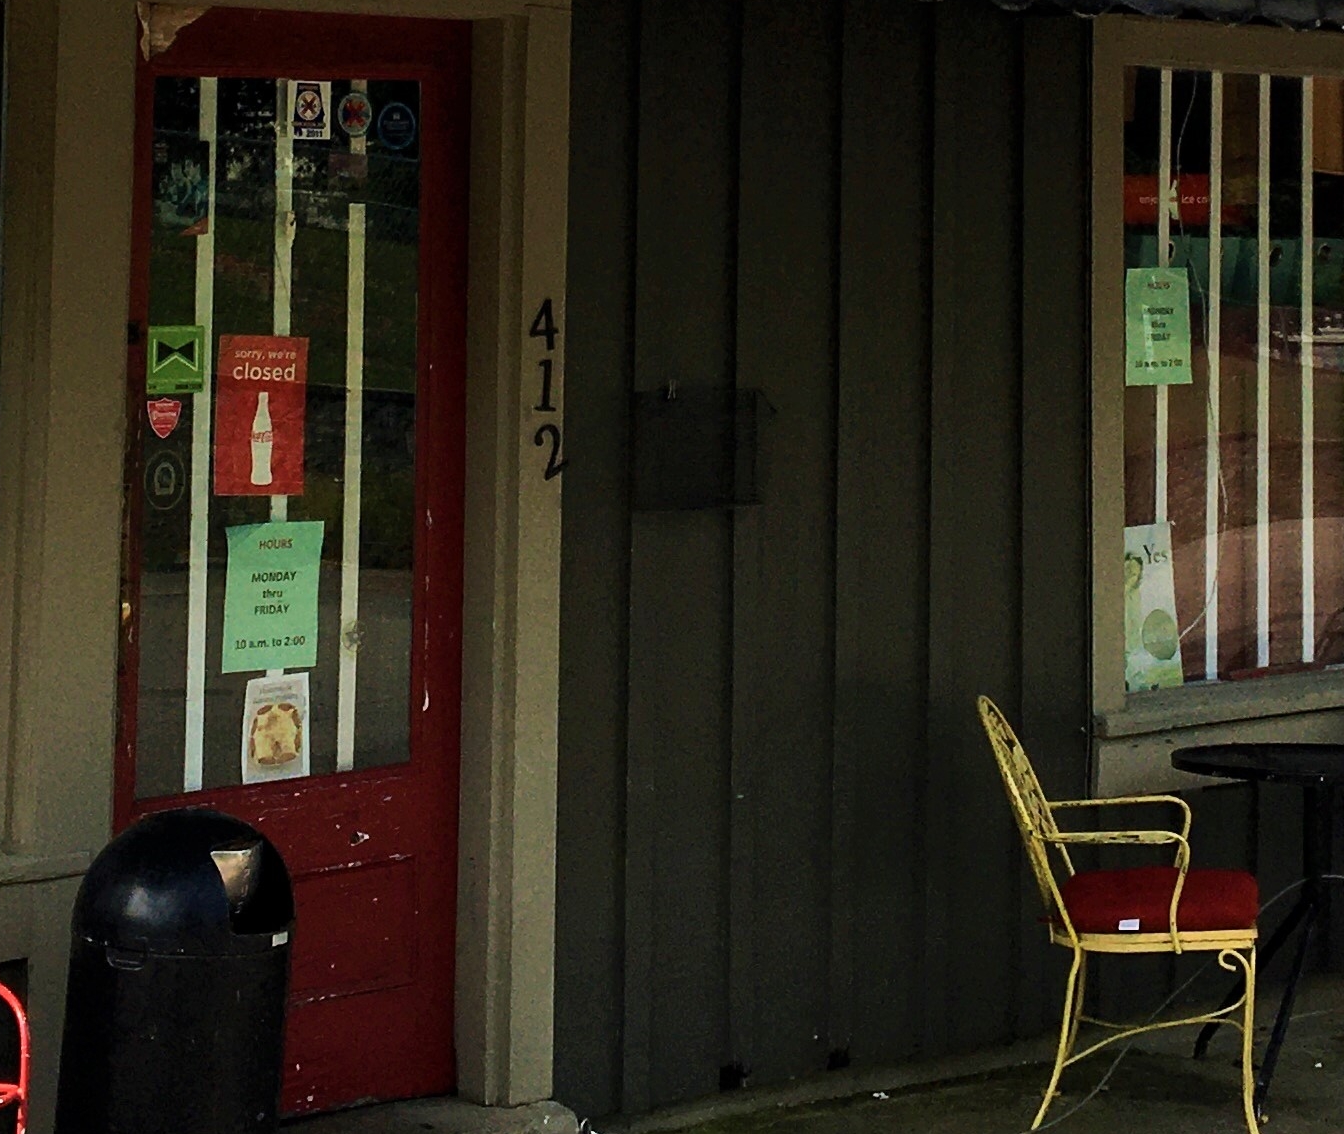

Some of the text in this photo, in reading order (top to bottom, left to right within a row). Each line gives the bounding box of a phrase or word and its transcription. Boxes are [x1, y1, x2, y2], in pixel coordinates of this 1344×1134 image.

[234, 349, 296, 361] sorry, we're
[232, 362, 296, 381] closed
[258, 538, 293, 550] HOURS
[1143, 544, 1168, 565] Yes
[251, 571, 297, 583] MONDAY
[262, 588, 283, 599] thru
[254, 604, 290, 616] FRIDAY
[235, 639, 247, 650] 10
[272, 637, 282, 647] to
[284, 635, 306, 647] 2:00
